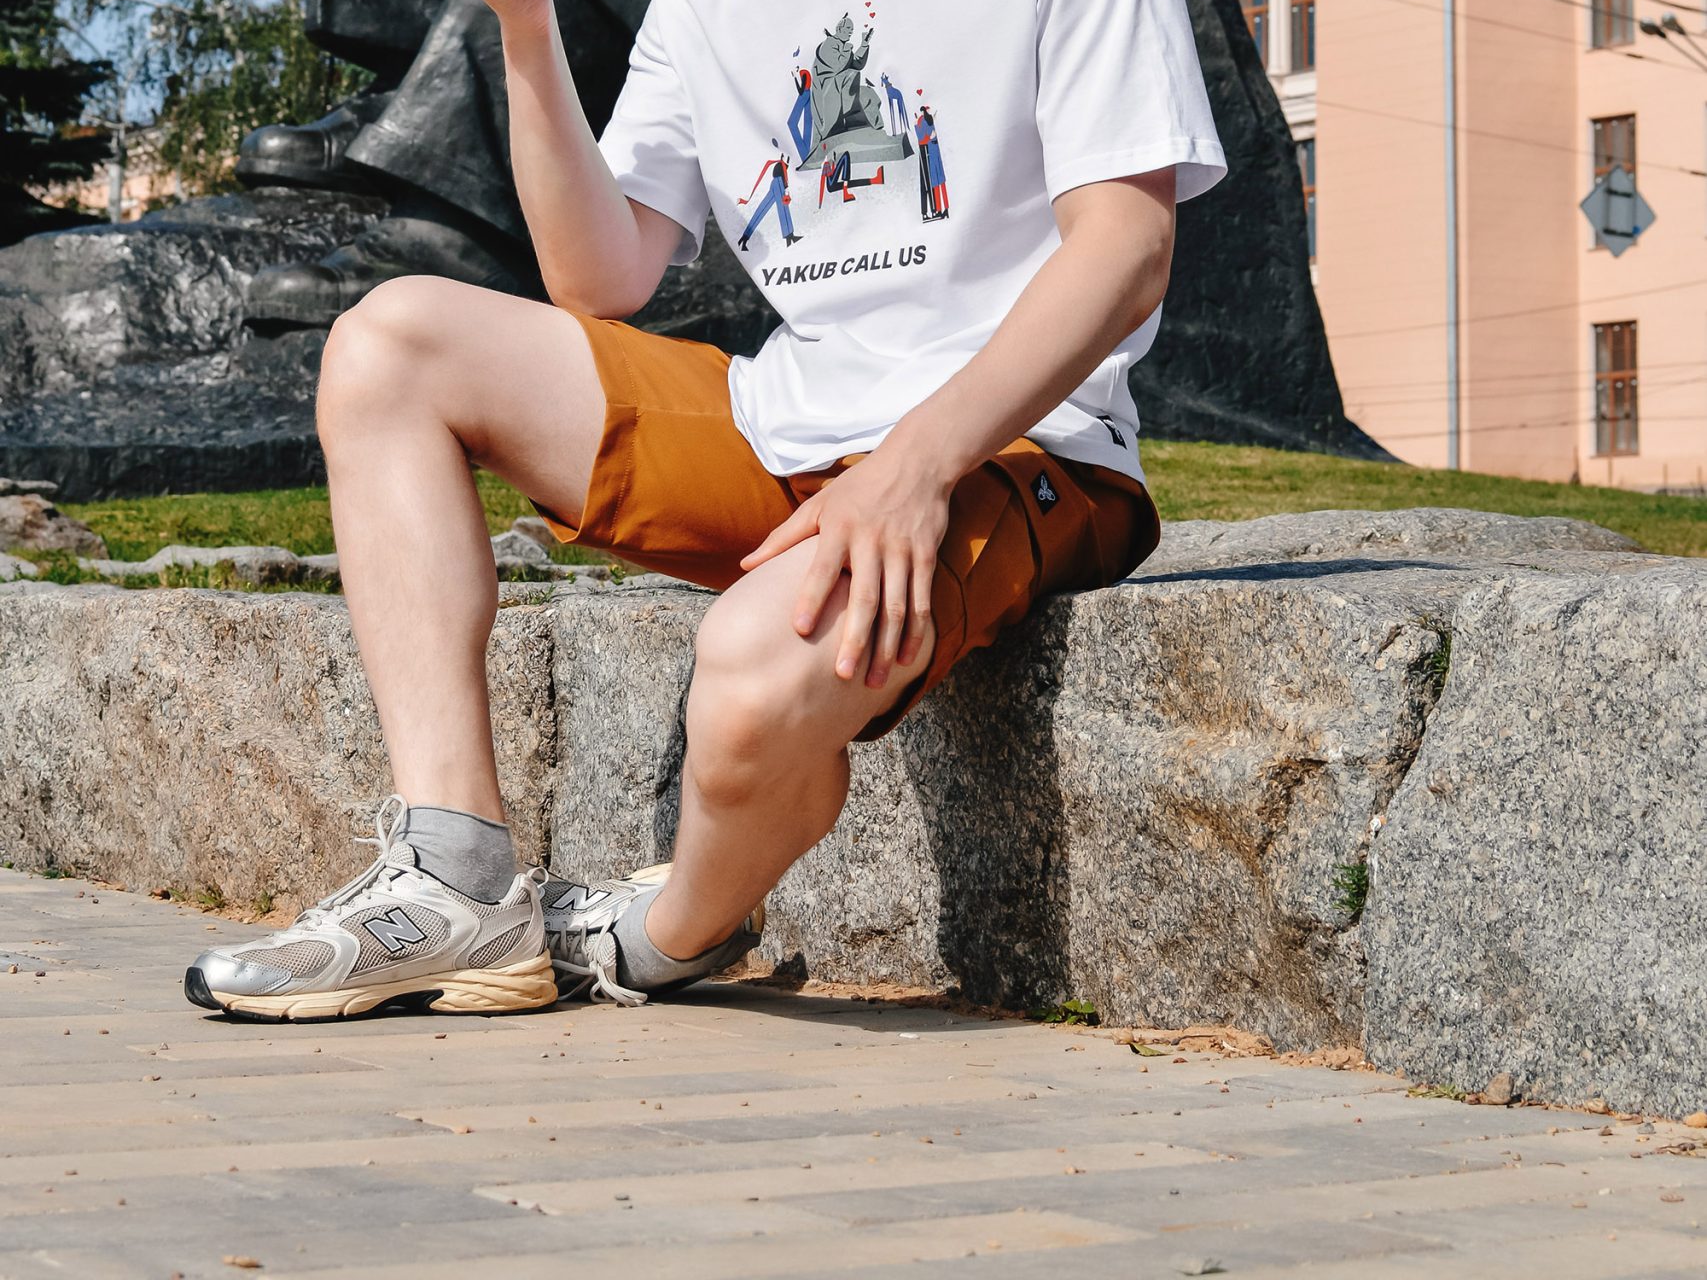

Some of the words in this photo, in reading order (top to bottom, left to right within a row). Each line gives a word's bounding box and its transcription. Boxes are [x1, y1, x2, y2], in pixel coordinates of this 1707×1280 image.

[762, 261, 838, 286] YAKUB
[840, 250, 892, 275] CALL
[899, 245, 926, 266] US
[549, 884, 612, 911] N
[363, 907, 427, 953] N
